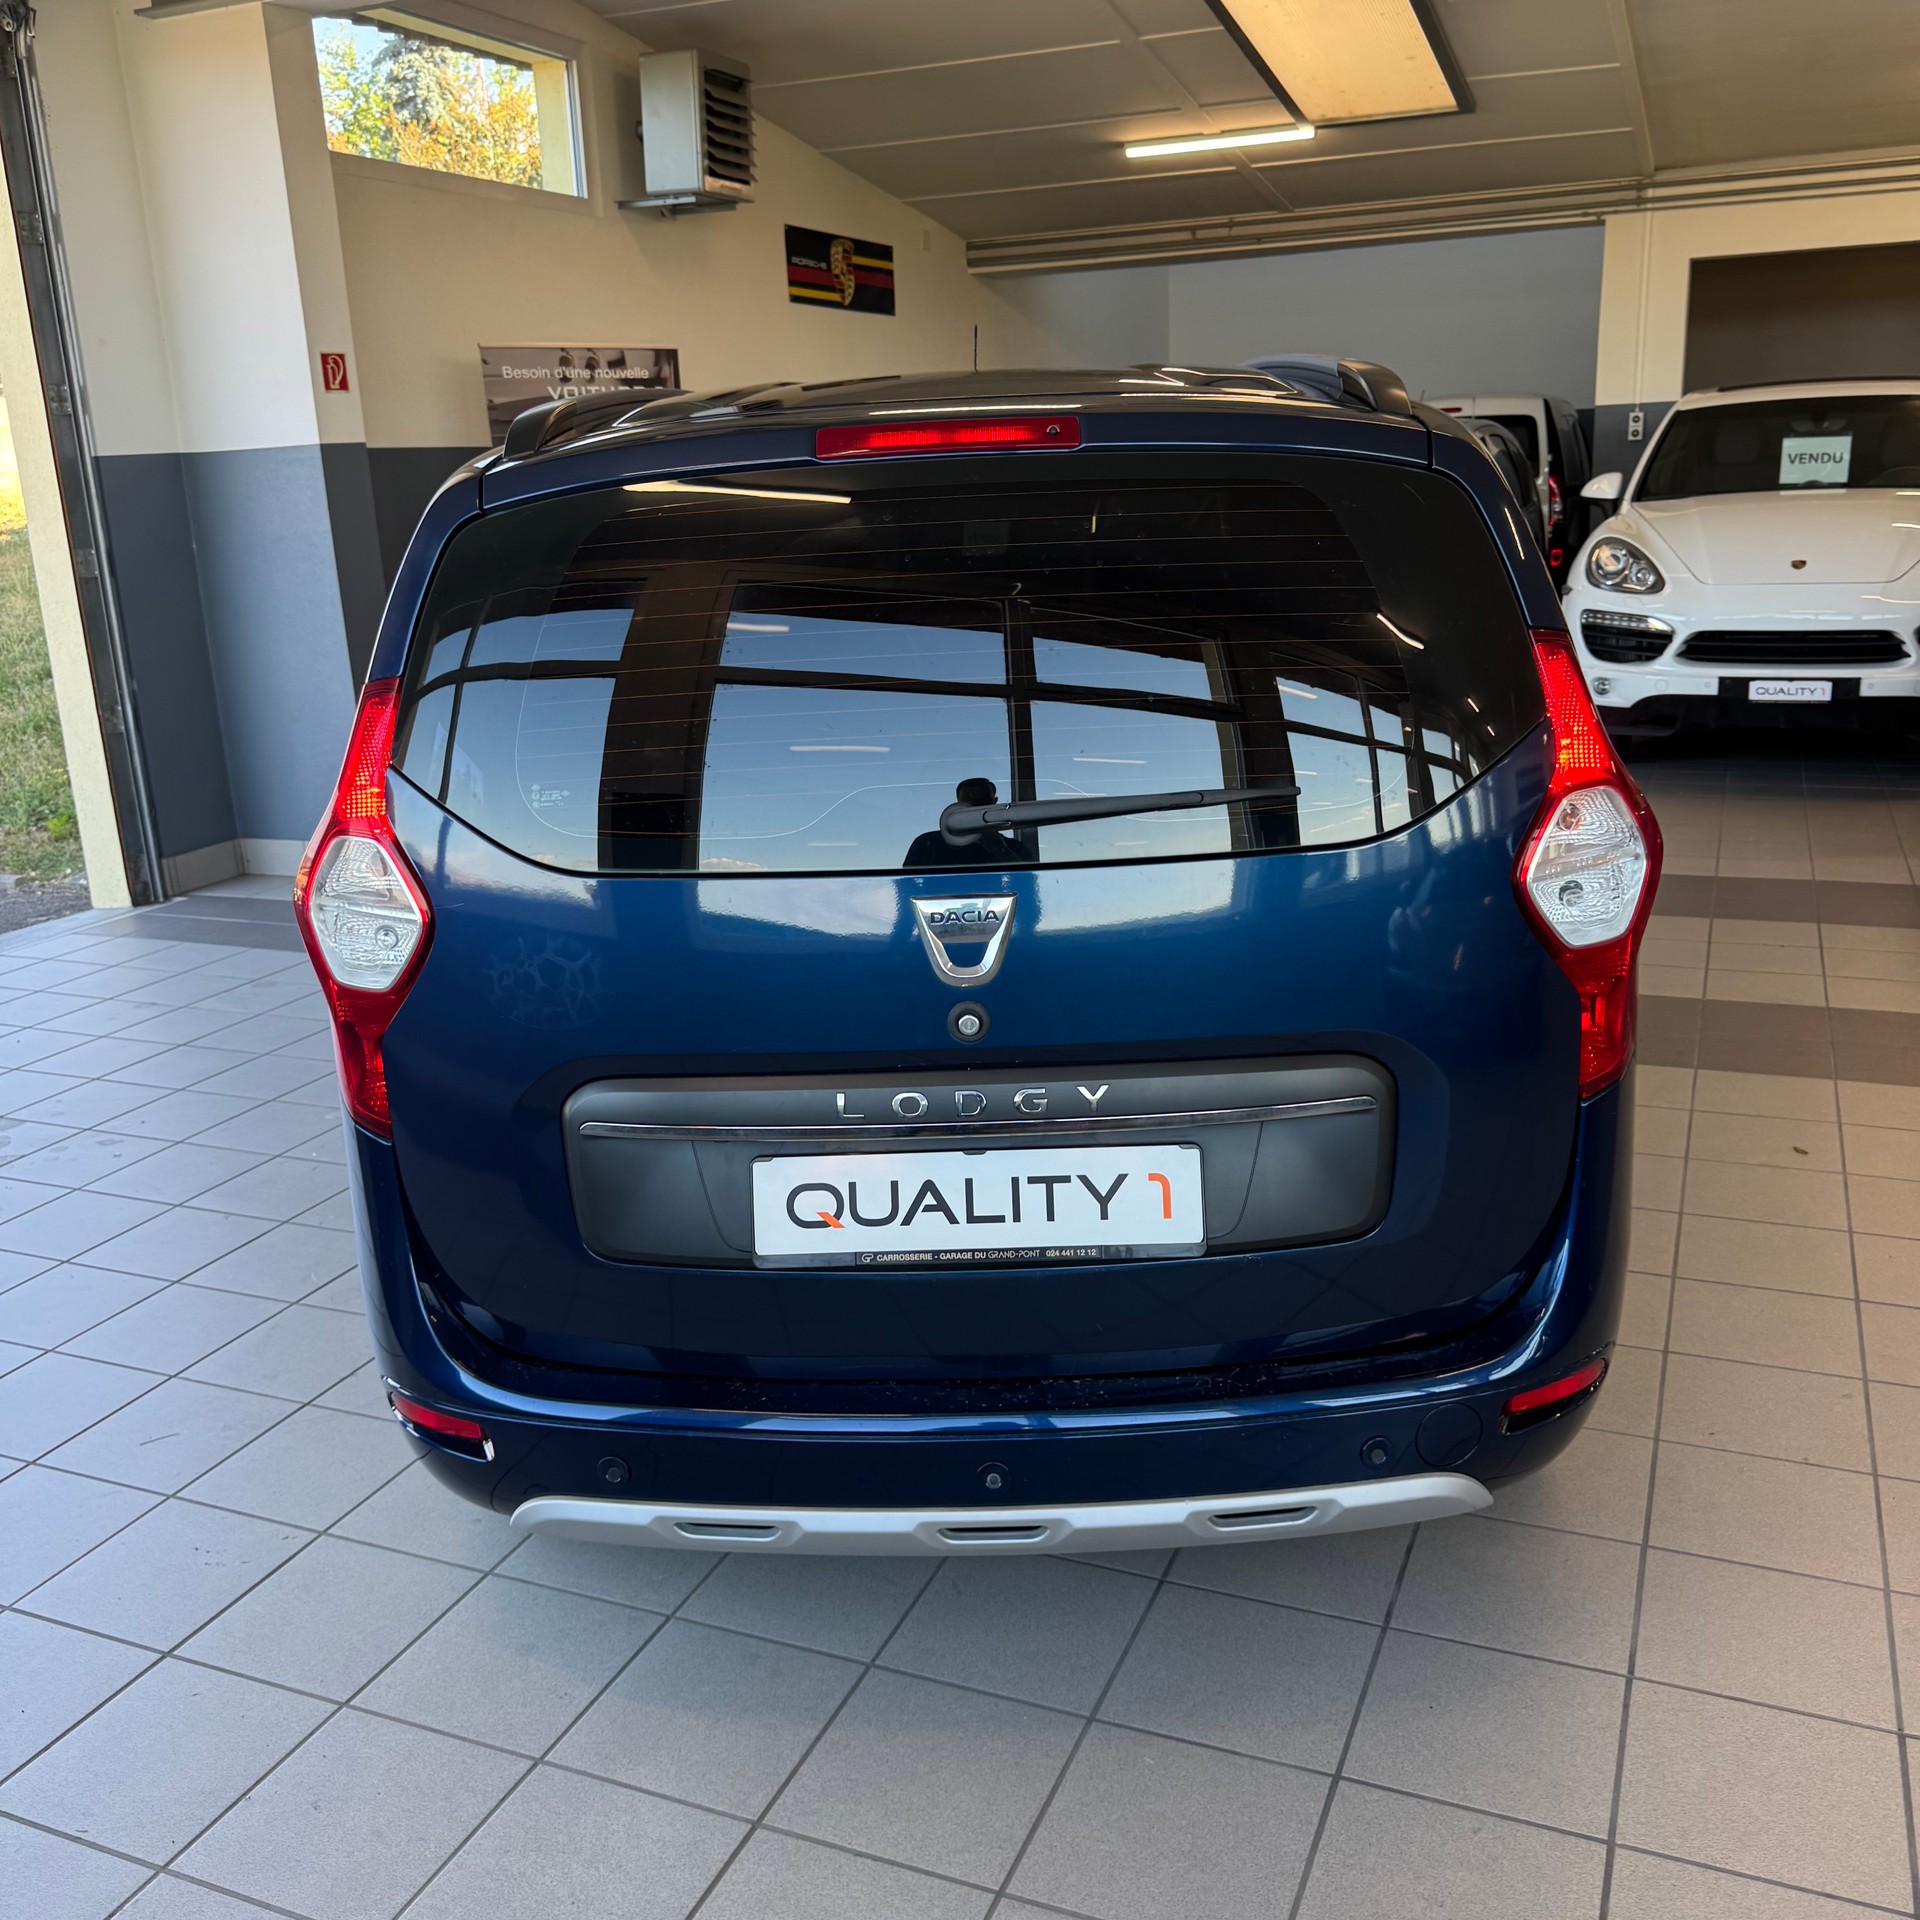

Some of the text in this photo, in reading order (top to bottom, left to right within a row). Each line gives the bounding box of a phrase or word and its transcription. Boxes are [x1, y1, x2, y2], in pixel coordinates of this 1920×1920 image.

[501, 366, 649, 379] Besoin d'une nouvelle
[1788, 452, 1844, 465] VENDU
[1755, 686, 1826, 696] QUALITY 1
[930, 910, 1000, 925] DACIA
[836, 1084, 1110, 1119] LODGY
[785, 1172, 1172, 1229] QUALITY 1
[876, 1253, 933, 1262] CARROSSERIE
[939, 1252, 973, 1260] GARAGE
[974, 1251, 986, 1259] DU
[987, 1249, 1040, 1259] GRAND-PONT
[1045, 1249, 1060, 1257] 024
[1061, 1249, 1074, 1257] 441
[1087, 1248, 1097, 1256] 12
